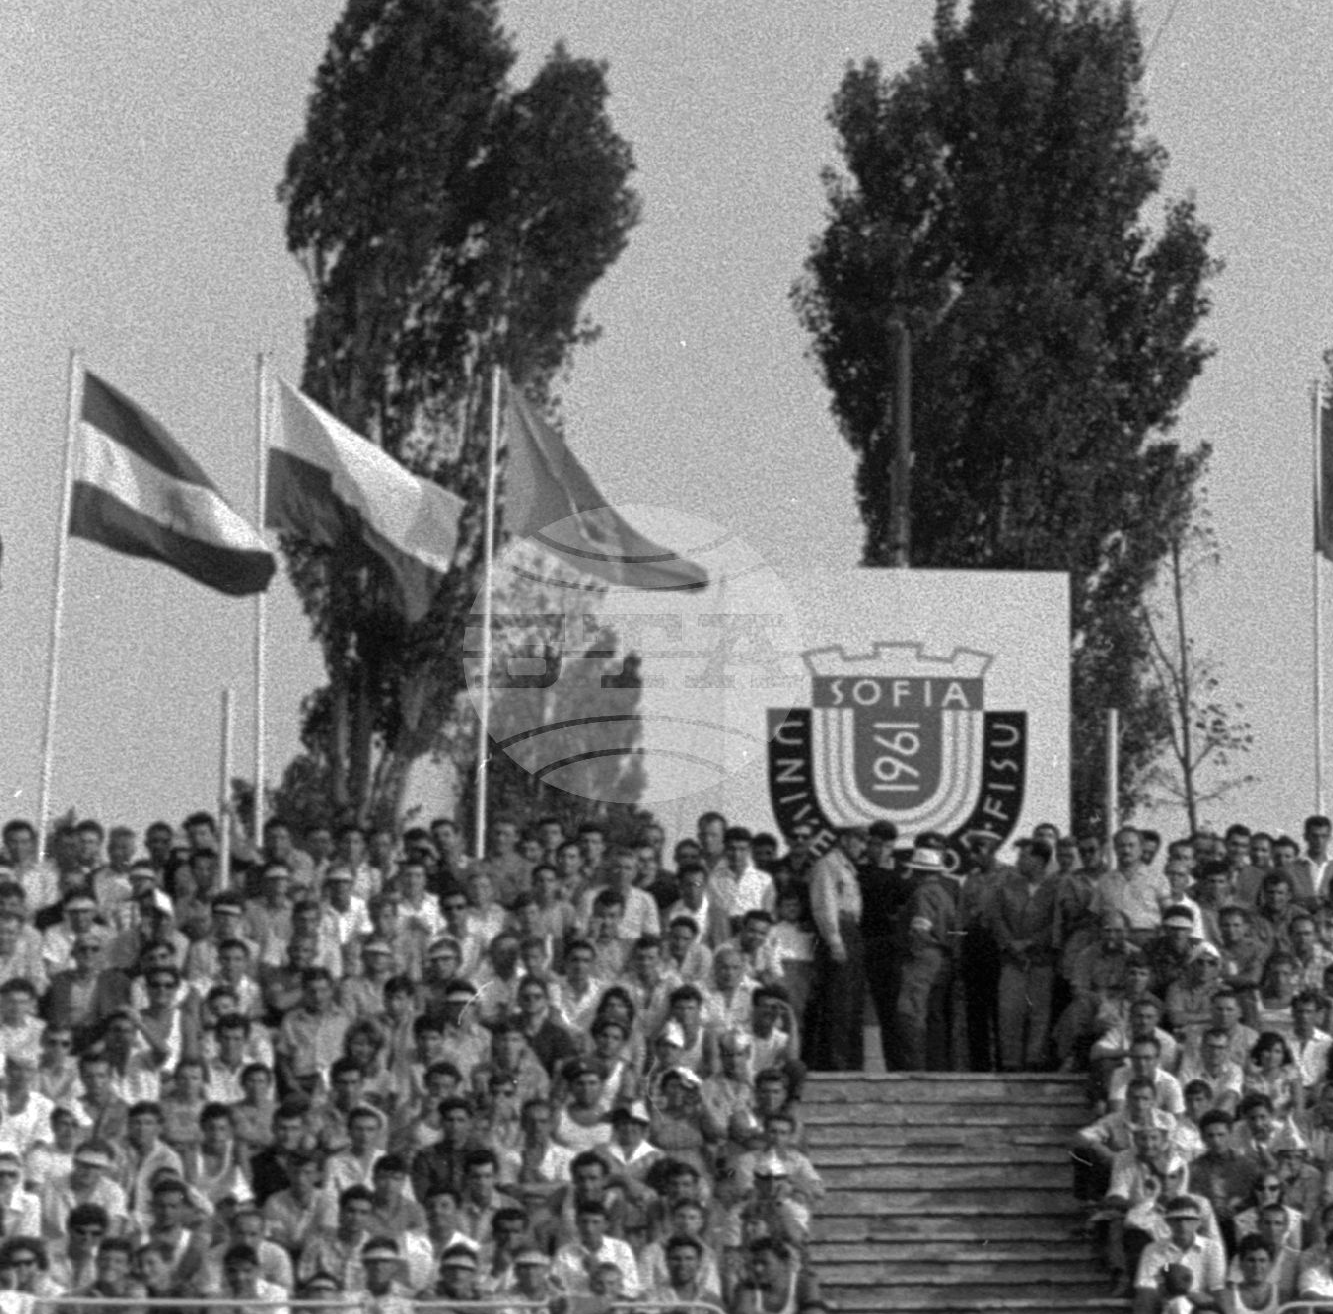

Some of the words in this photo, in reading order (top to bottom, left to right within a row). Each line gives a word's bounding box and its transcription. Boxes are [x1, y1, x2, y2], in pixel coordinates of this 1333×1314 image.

[830, 678, 969, 709] SOFIA
[871, 721, 921, 792] 1961
[982, 723, 1021, 821] FISU
